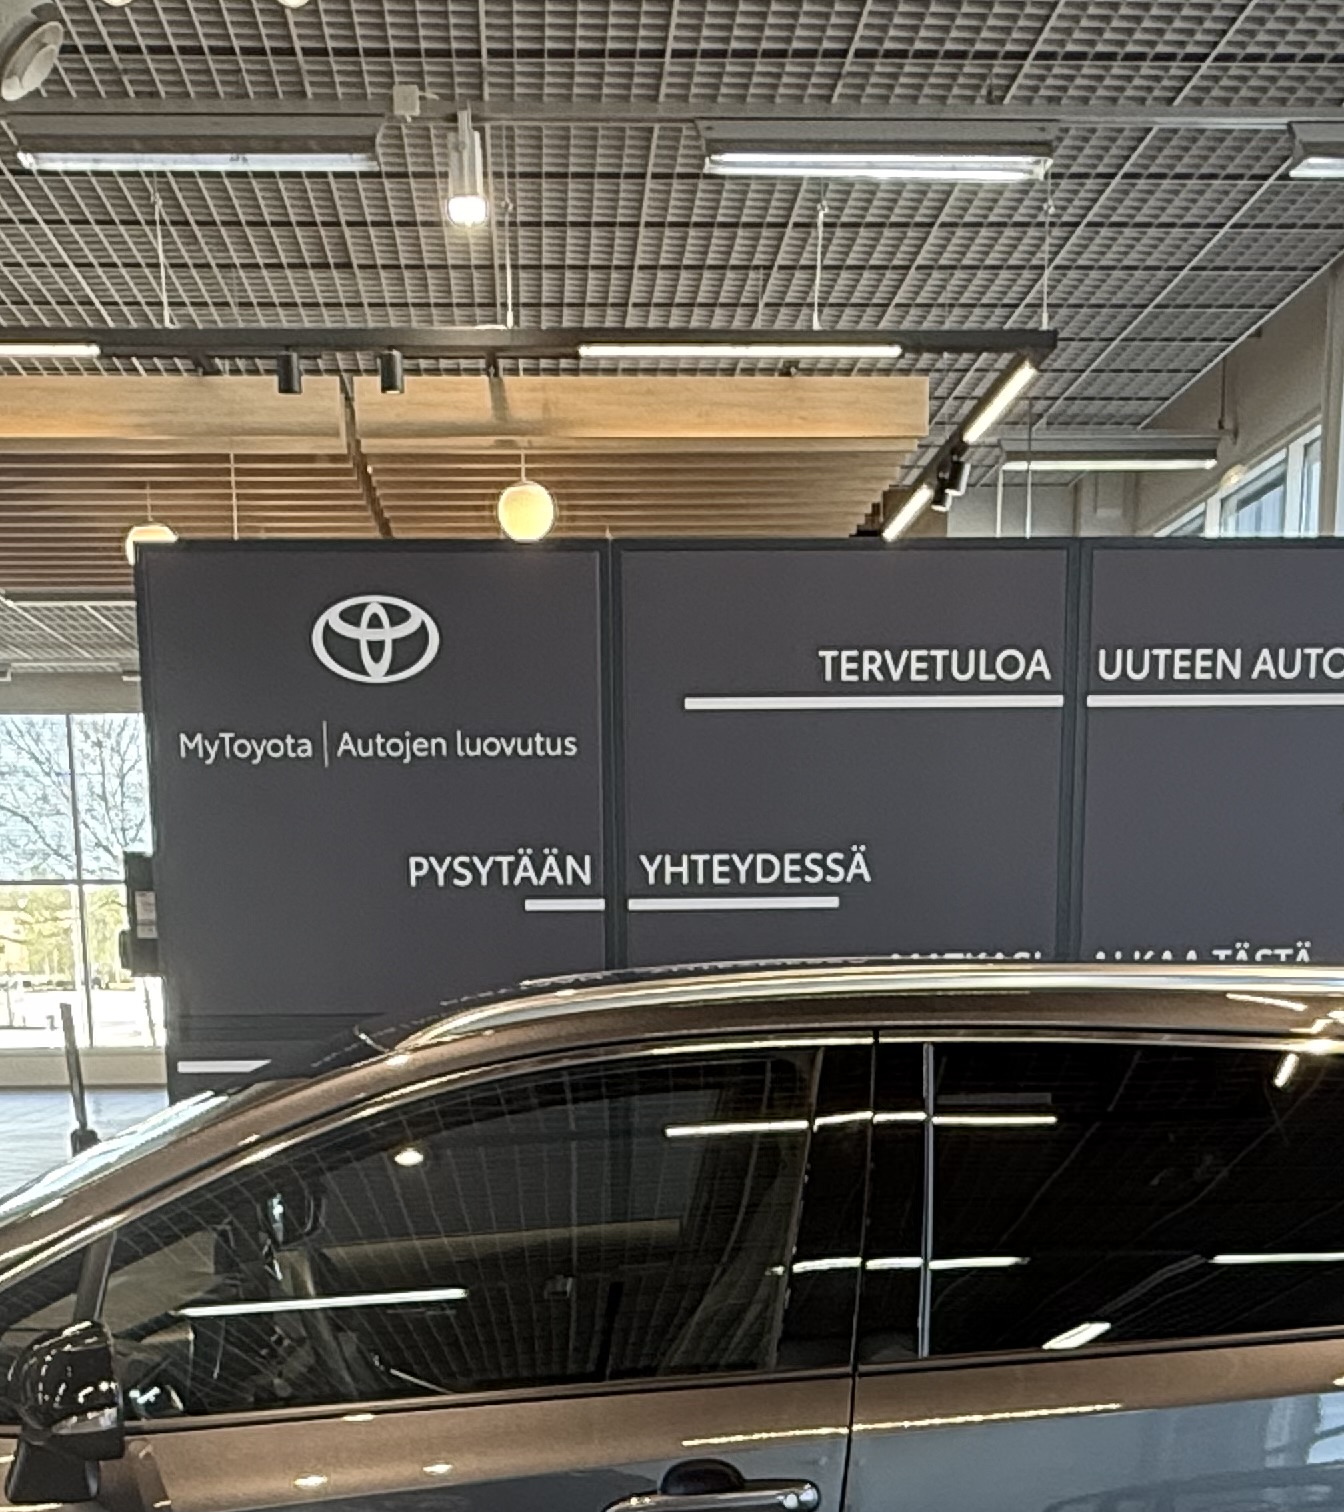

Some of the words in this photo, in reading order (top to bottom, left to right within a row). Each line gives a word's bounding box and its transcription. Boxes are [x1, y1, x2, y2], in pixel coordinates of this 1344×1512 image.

[818, 648, 1052, 682] TERVETULOA
[1098, 648, 1242, 681] UUTEEN
[179, 732, 313, 765] MyToyota
[336, 730, 447, 764] Autojen
[456, 730, 578, 757] luovutus
[408, 847, 592, 888] PYSYTÄÄN
[639, 844, 872, 885] YHTEYDESSÄ
